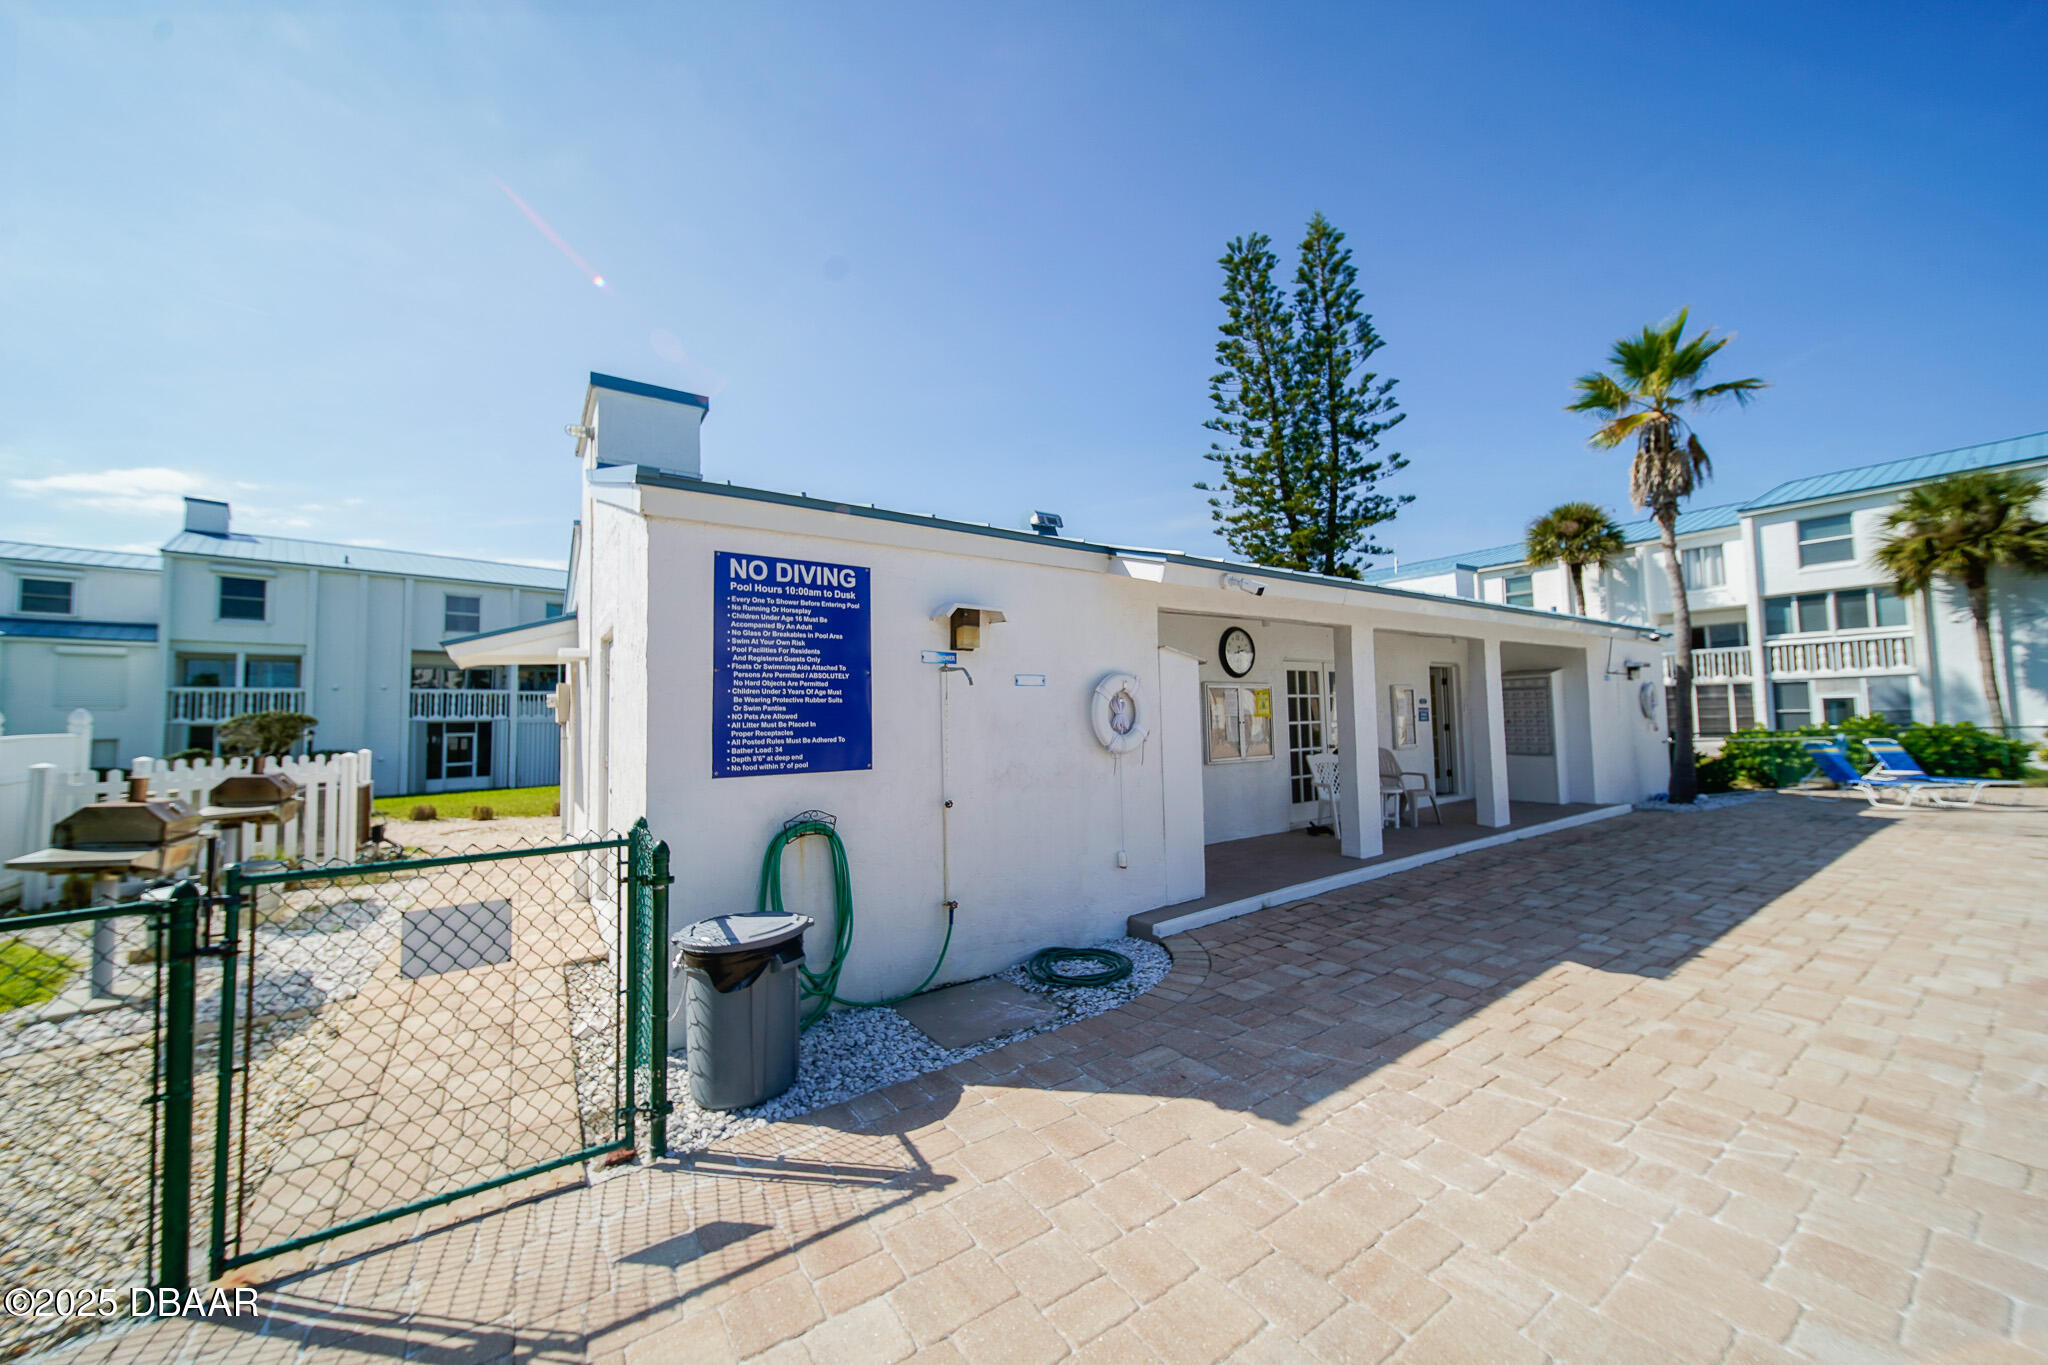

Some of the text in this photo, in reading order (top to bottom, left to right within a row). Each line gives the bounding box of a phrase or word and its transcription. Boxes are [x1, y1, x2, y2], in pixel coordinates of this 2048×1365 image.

[730, 558, 856, 588] NO DIVING
[730, 582, 751, 591] Pool
[755, 584, 782, 593] Hours
[786, 587, 821, 597] 10:00am
[834, 591, 856, 599] Dusk
[822, 600, 846, 609] Entering
